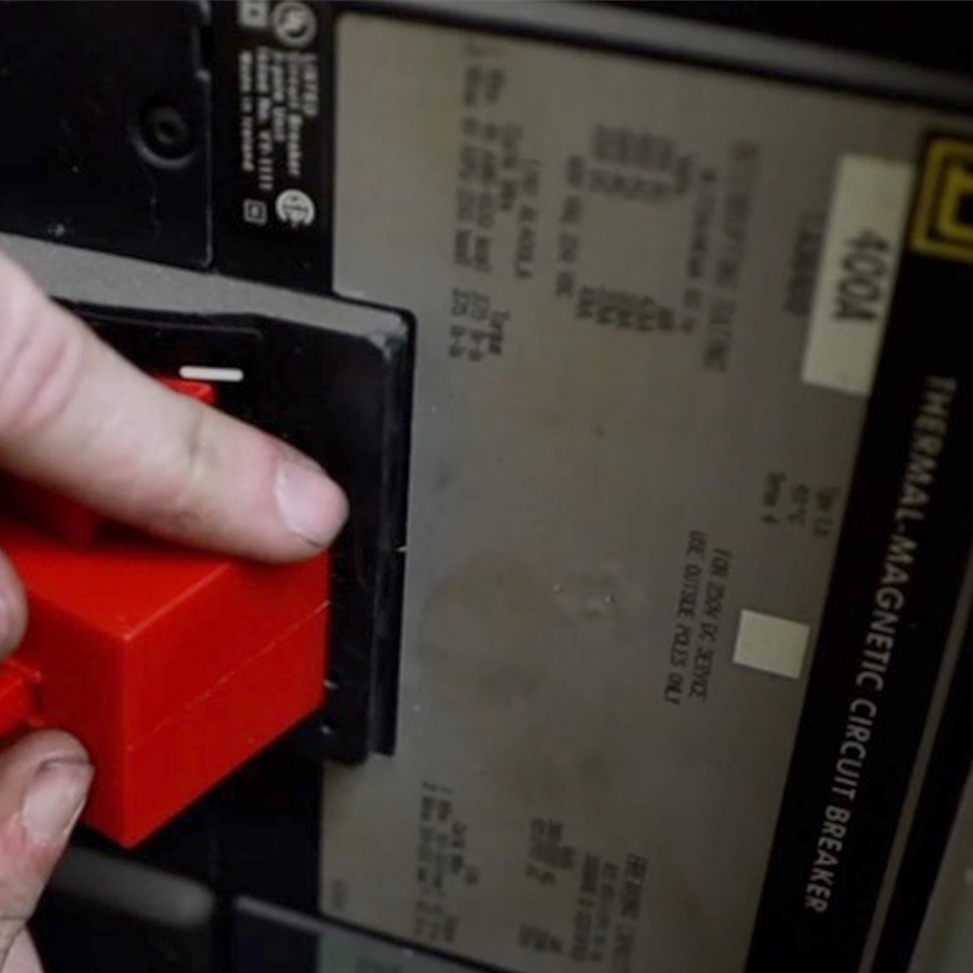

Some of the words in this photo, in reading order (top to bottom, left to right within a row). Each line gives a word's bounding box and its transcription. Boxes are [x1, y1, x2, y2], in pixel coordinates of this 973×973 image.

[288, 114, 304, 177] Breaker
[833, 227, 890, 324] 400A
[853, 373, 956, 692] THERMAL-MAGNETIC
[676, 563, 701, 619] OUTSIDE
[670, 624, 692, 667] POLES
[687, 647, 714, 702] SERVICE
[663, 671, 684, 704] ONLY
[828, 698, 877, 801] CIRCUIT
[802, 803, 851, 913] BREAKER
